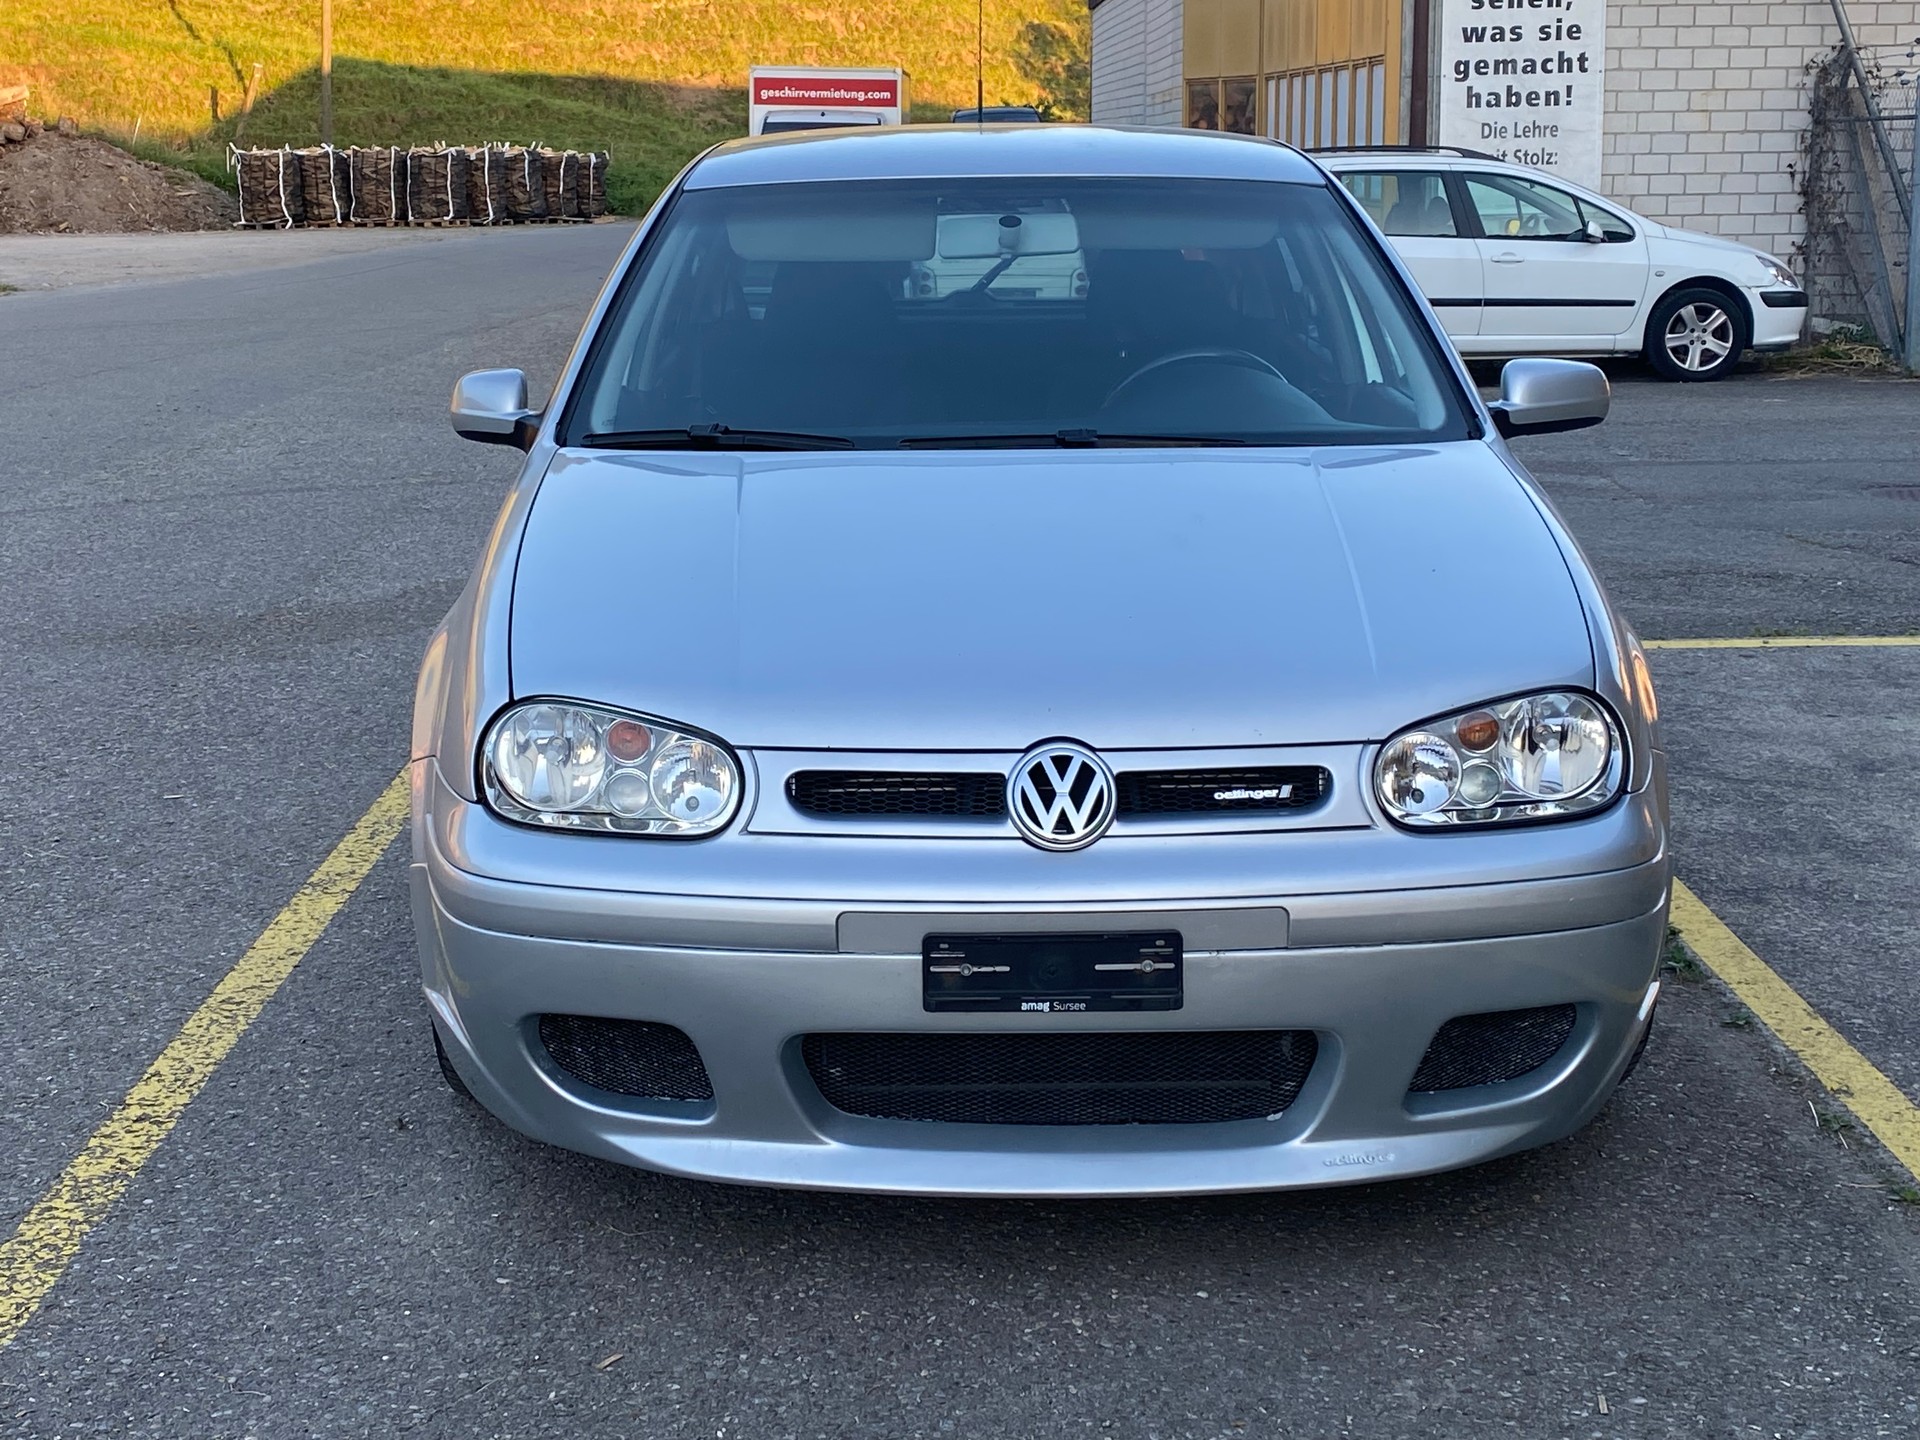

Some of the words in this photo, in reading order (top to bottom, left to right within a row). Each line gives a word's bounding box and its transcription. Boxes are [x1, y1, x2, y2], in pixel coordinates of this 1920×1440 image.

[1461, 25, 1524, 43] was
[1538, 18, 1582, 42] sie
[1453, 51, 1589, 82] gemacht
[760, 86, 891, 102] geschirrvermietung.com
[1466, 85, 1574, 109] haben!
[1481, 121, 1508, 139] Die
[1513, 120, 1559, 139] Lehre
[1490, 148, 1508, 161] it
[1513, 147, 1558, 165] Stolz:
[1014, 746, 1110, 843] VW
[1021, 1001, 1050, 1013] amag
[1053, 1001, 1086, 1011] Sursee
